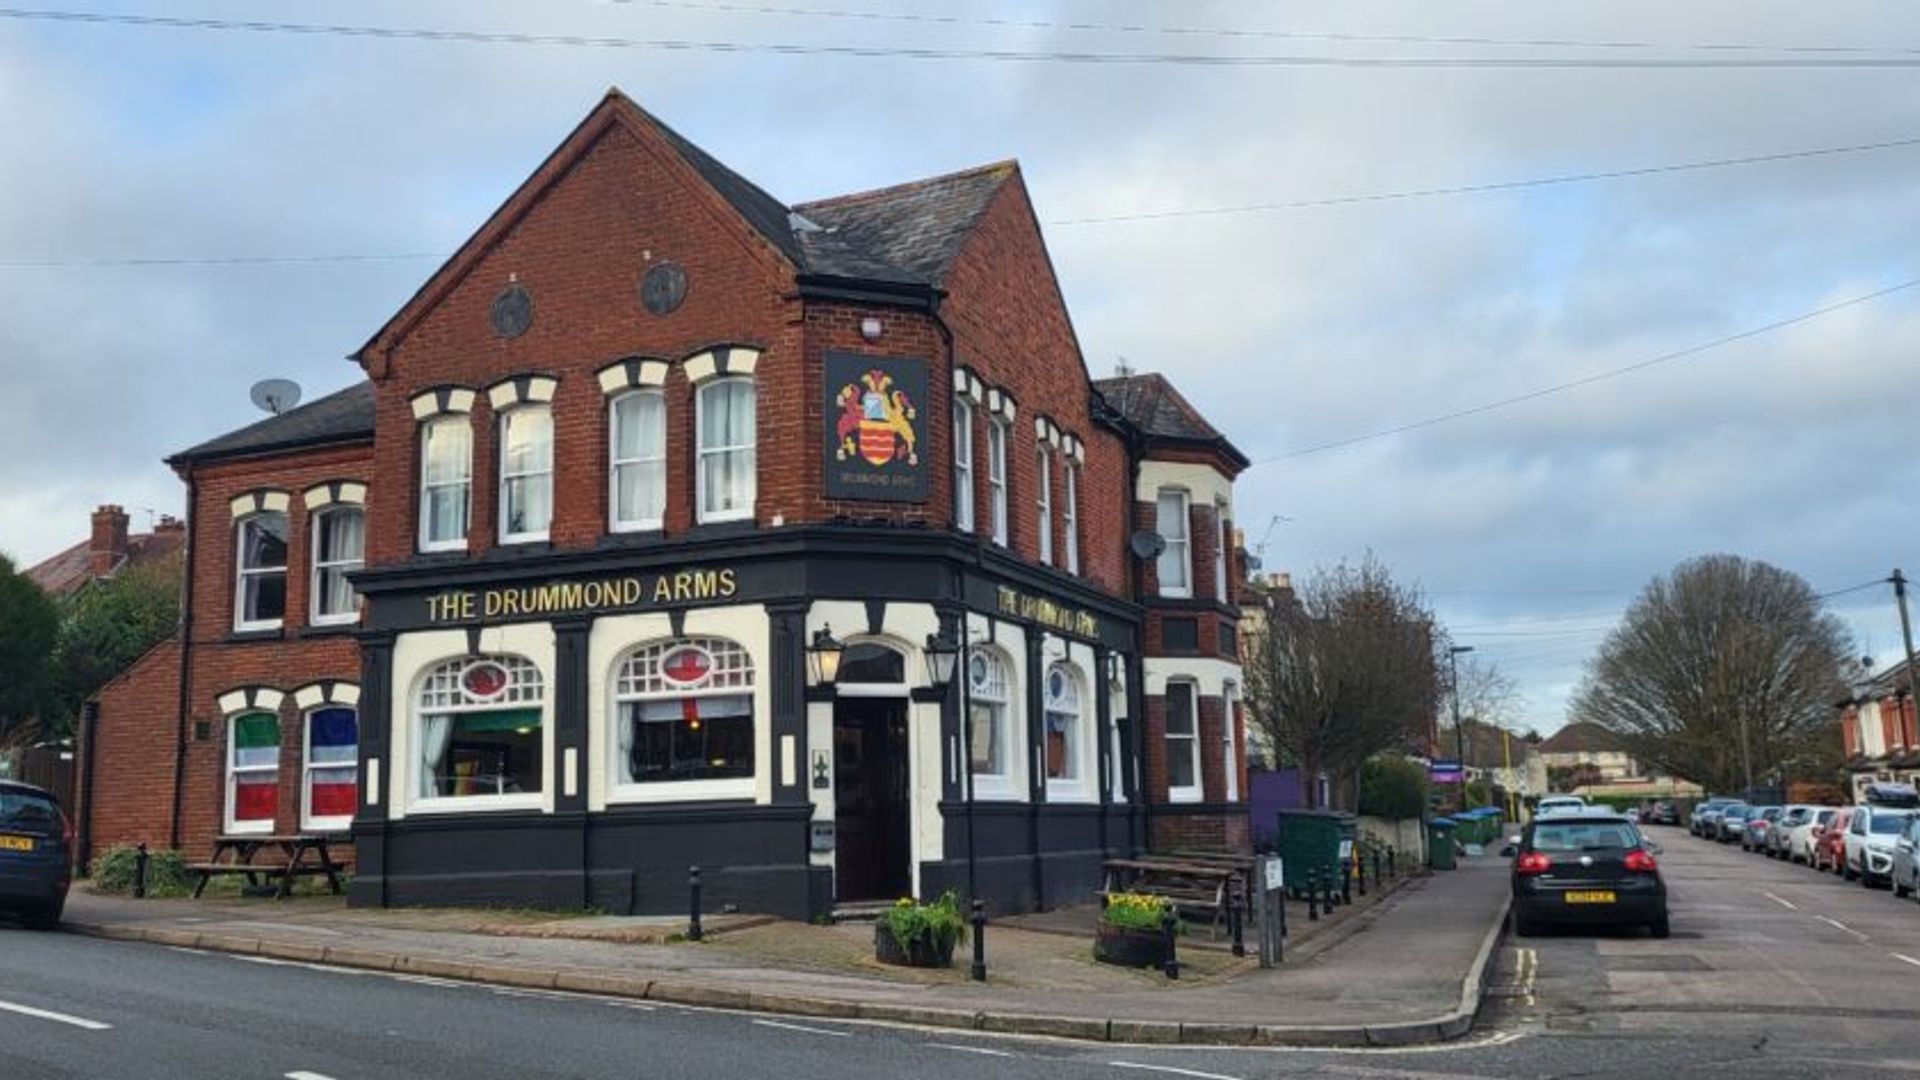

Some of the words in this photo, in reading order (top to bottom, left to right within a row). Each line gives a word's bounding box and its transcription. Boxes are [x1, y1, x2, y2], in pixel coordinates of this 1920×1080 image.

[425, 592, 477, 621] THE
[485, 578, 641, 616] DRUMMOND
[653, 568, 736, 602] ARMS
